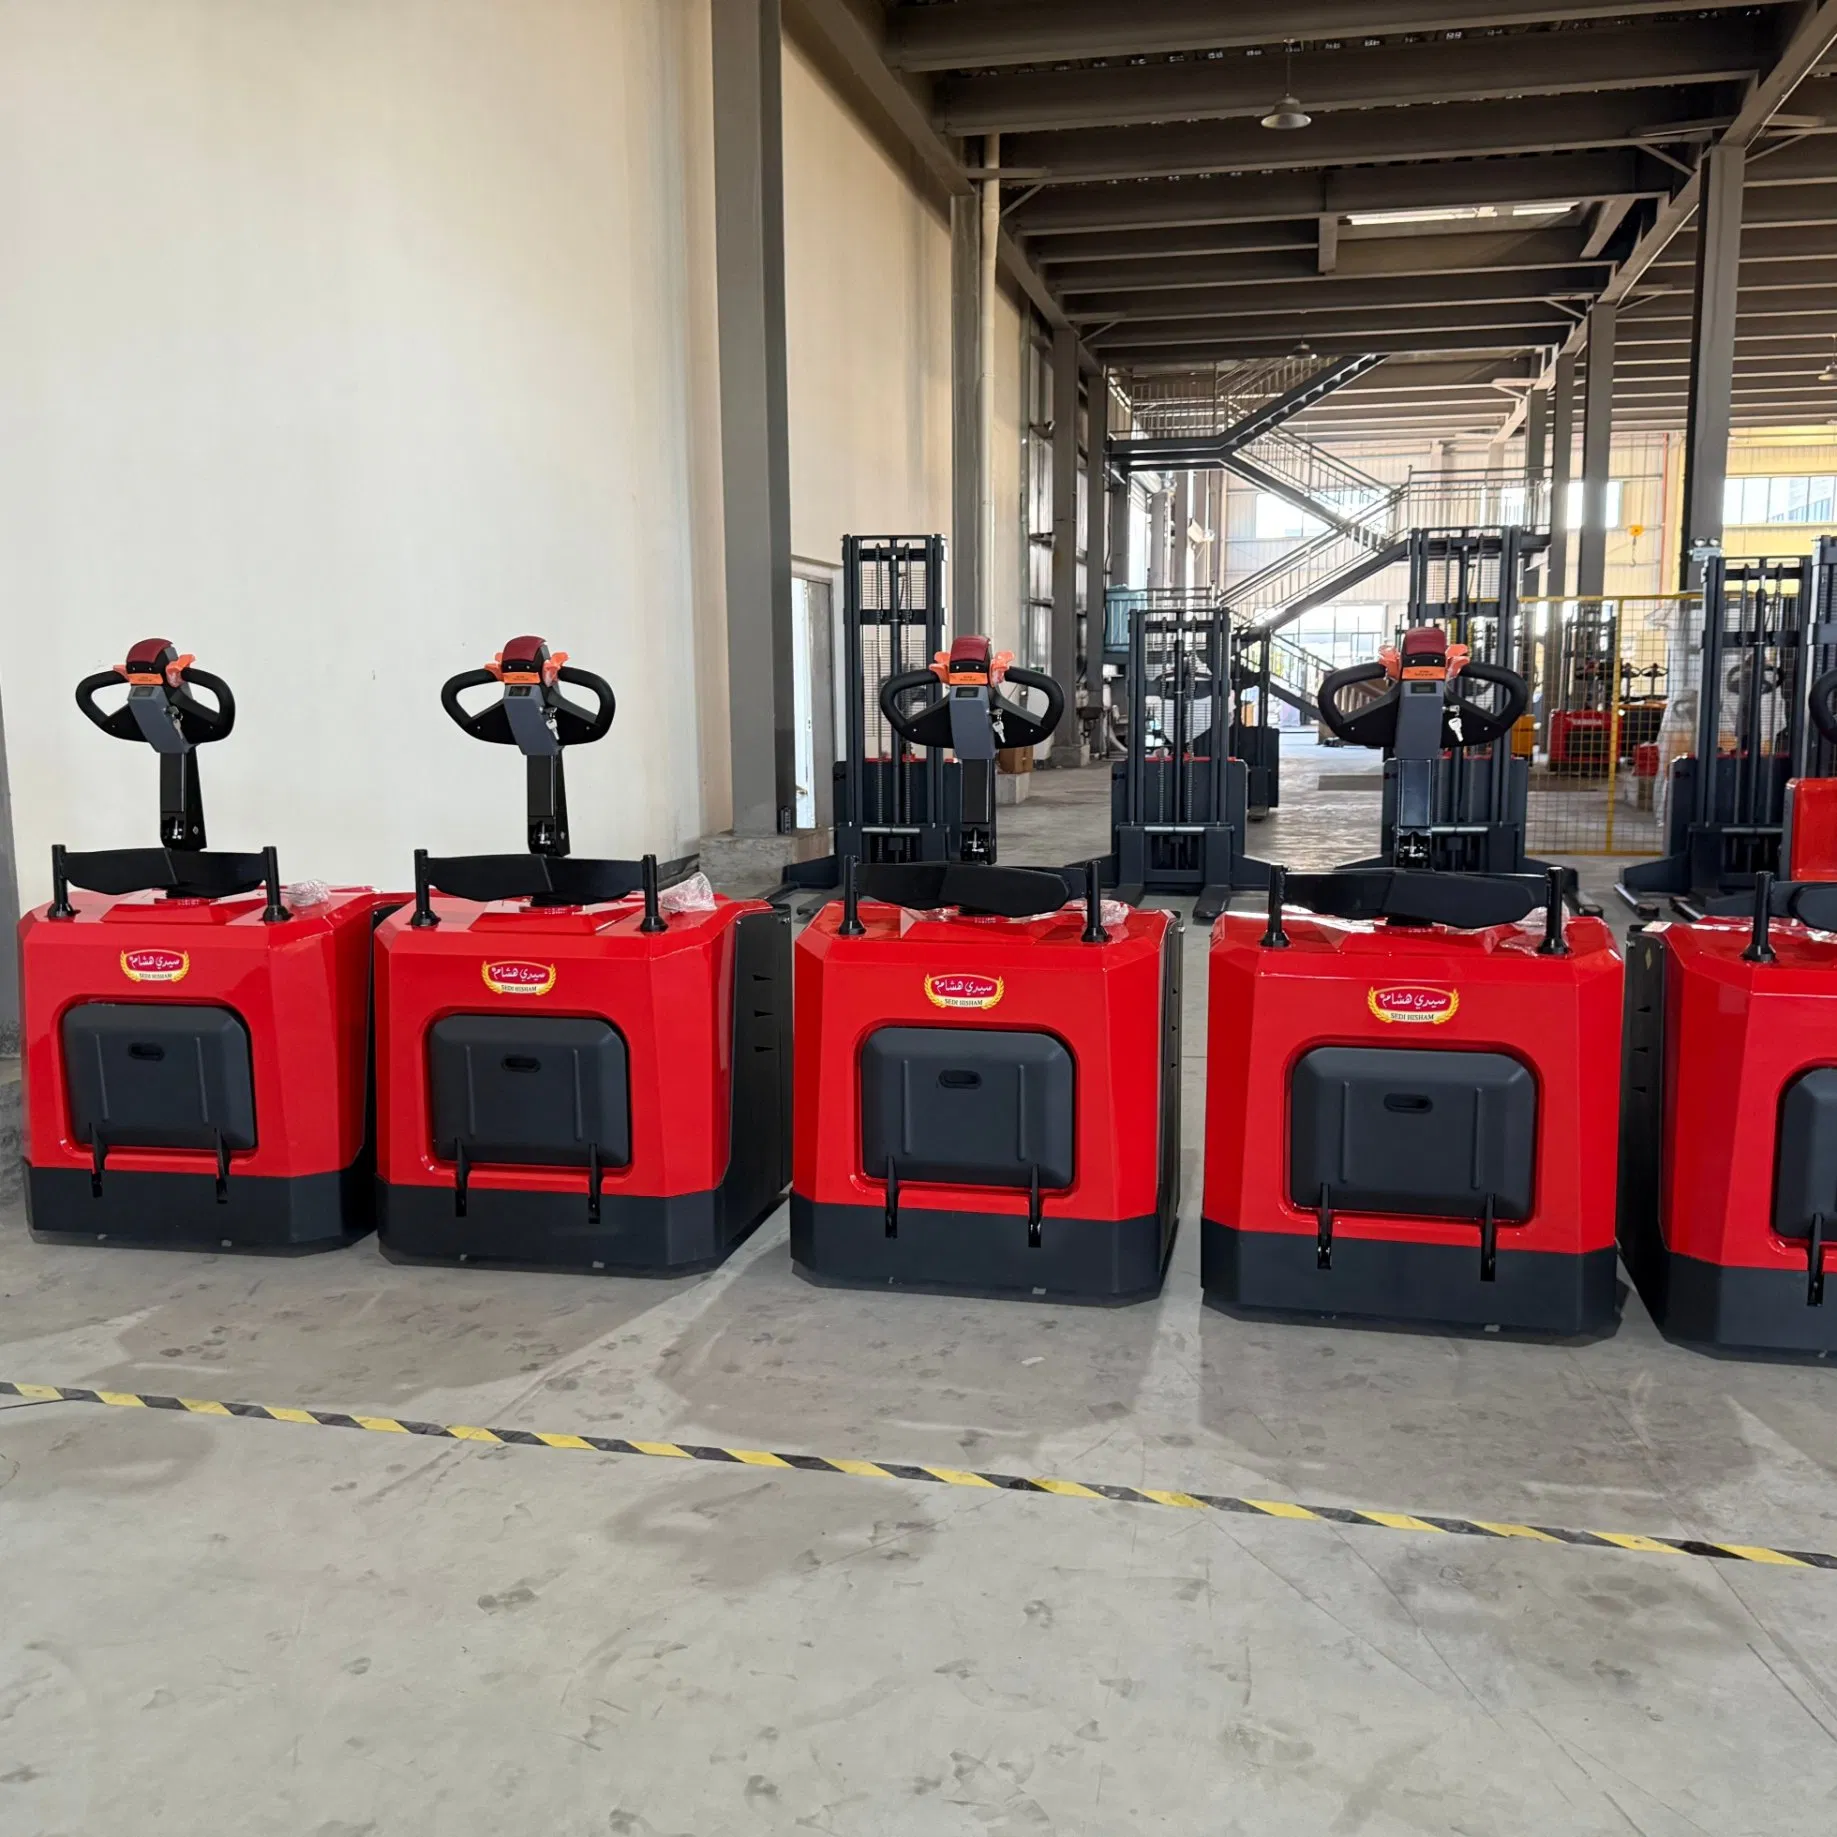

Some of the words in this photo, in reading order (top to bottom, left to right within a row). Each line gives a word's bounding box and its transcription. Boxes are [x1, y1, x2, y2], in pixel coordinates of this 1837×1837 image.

[965, 981, 993, 996] سيدي
[1414, 994, 1447, 1010] سيدي
[1390, 1012, 1406, 1020] SEDI
